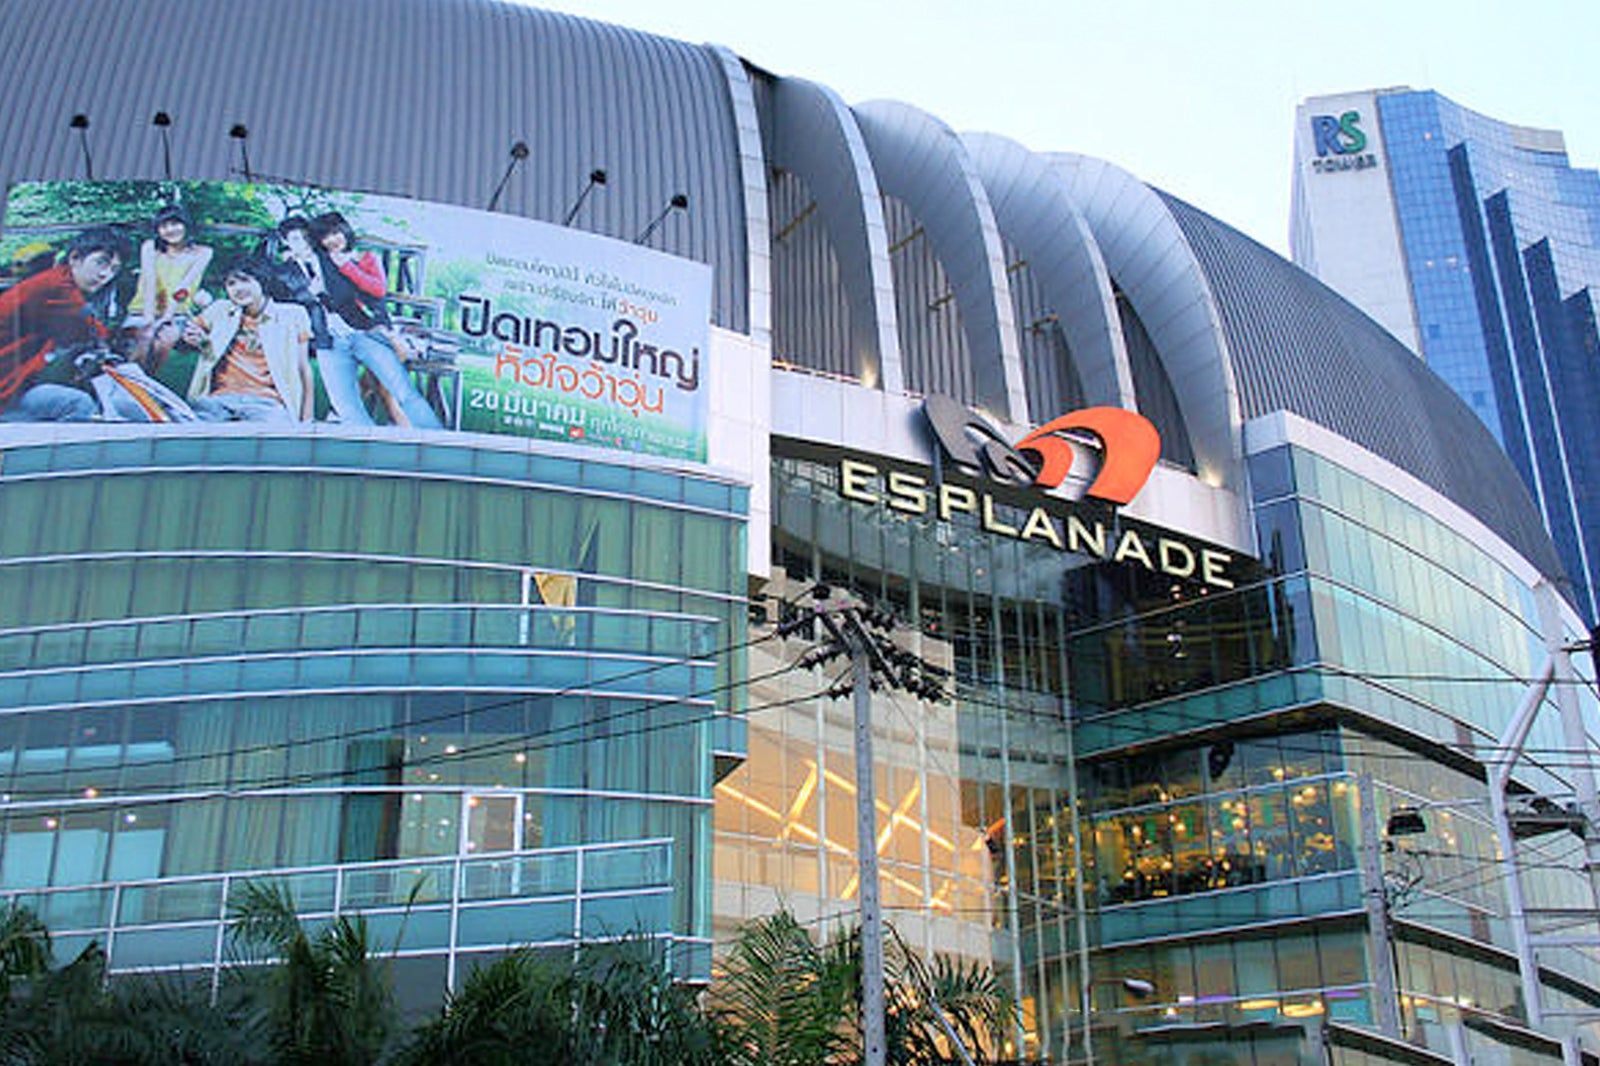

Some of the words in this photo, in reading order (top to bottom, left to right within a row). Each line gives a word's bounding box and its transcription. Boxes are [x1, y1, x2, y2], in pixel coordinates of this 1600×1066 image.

[1311, 110, 1366, 157] RS
[459, 294, 699, 392] ปิดเทอมใหญ่
[470, 389, 499, 411] 20
[840, 459, 1235, 589] ESPLANADE
